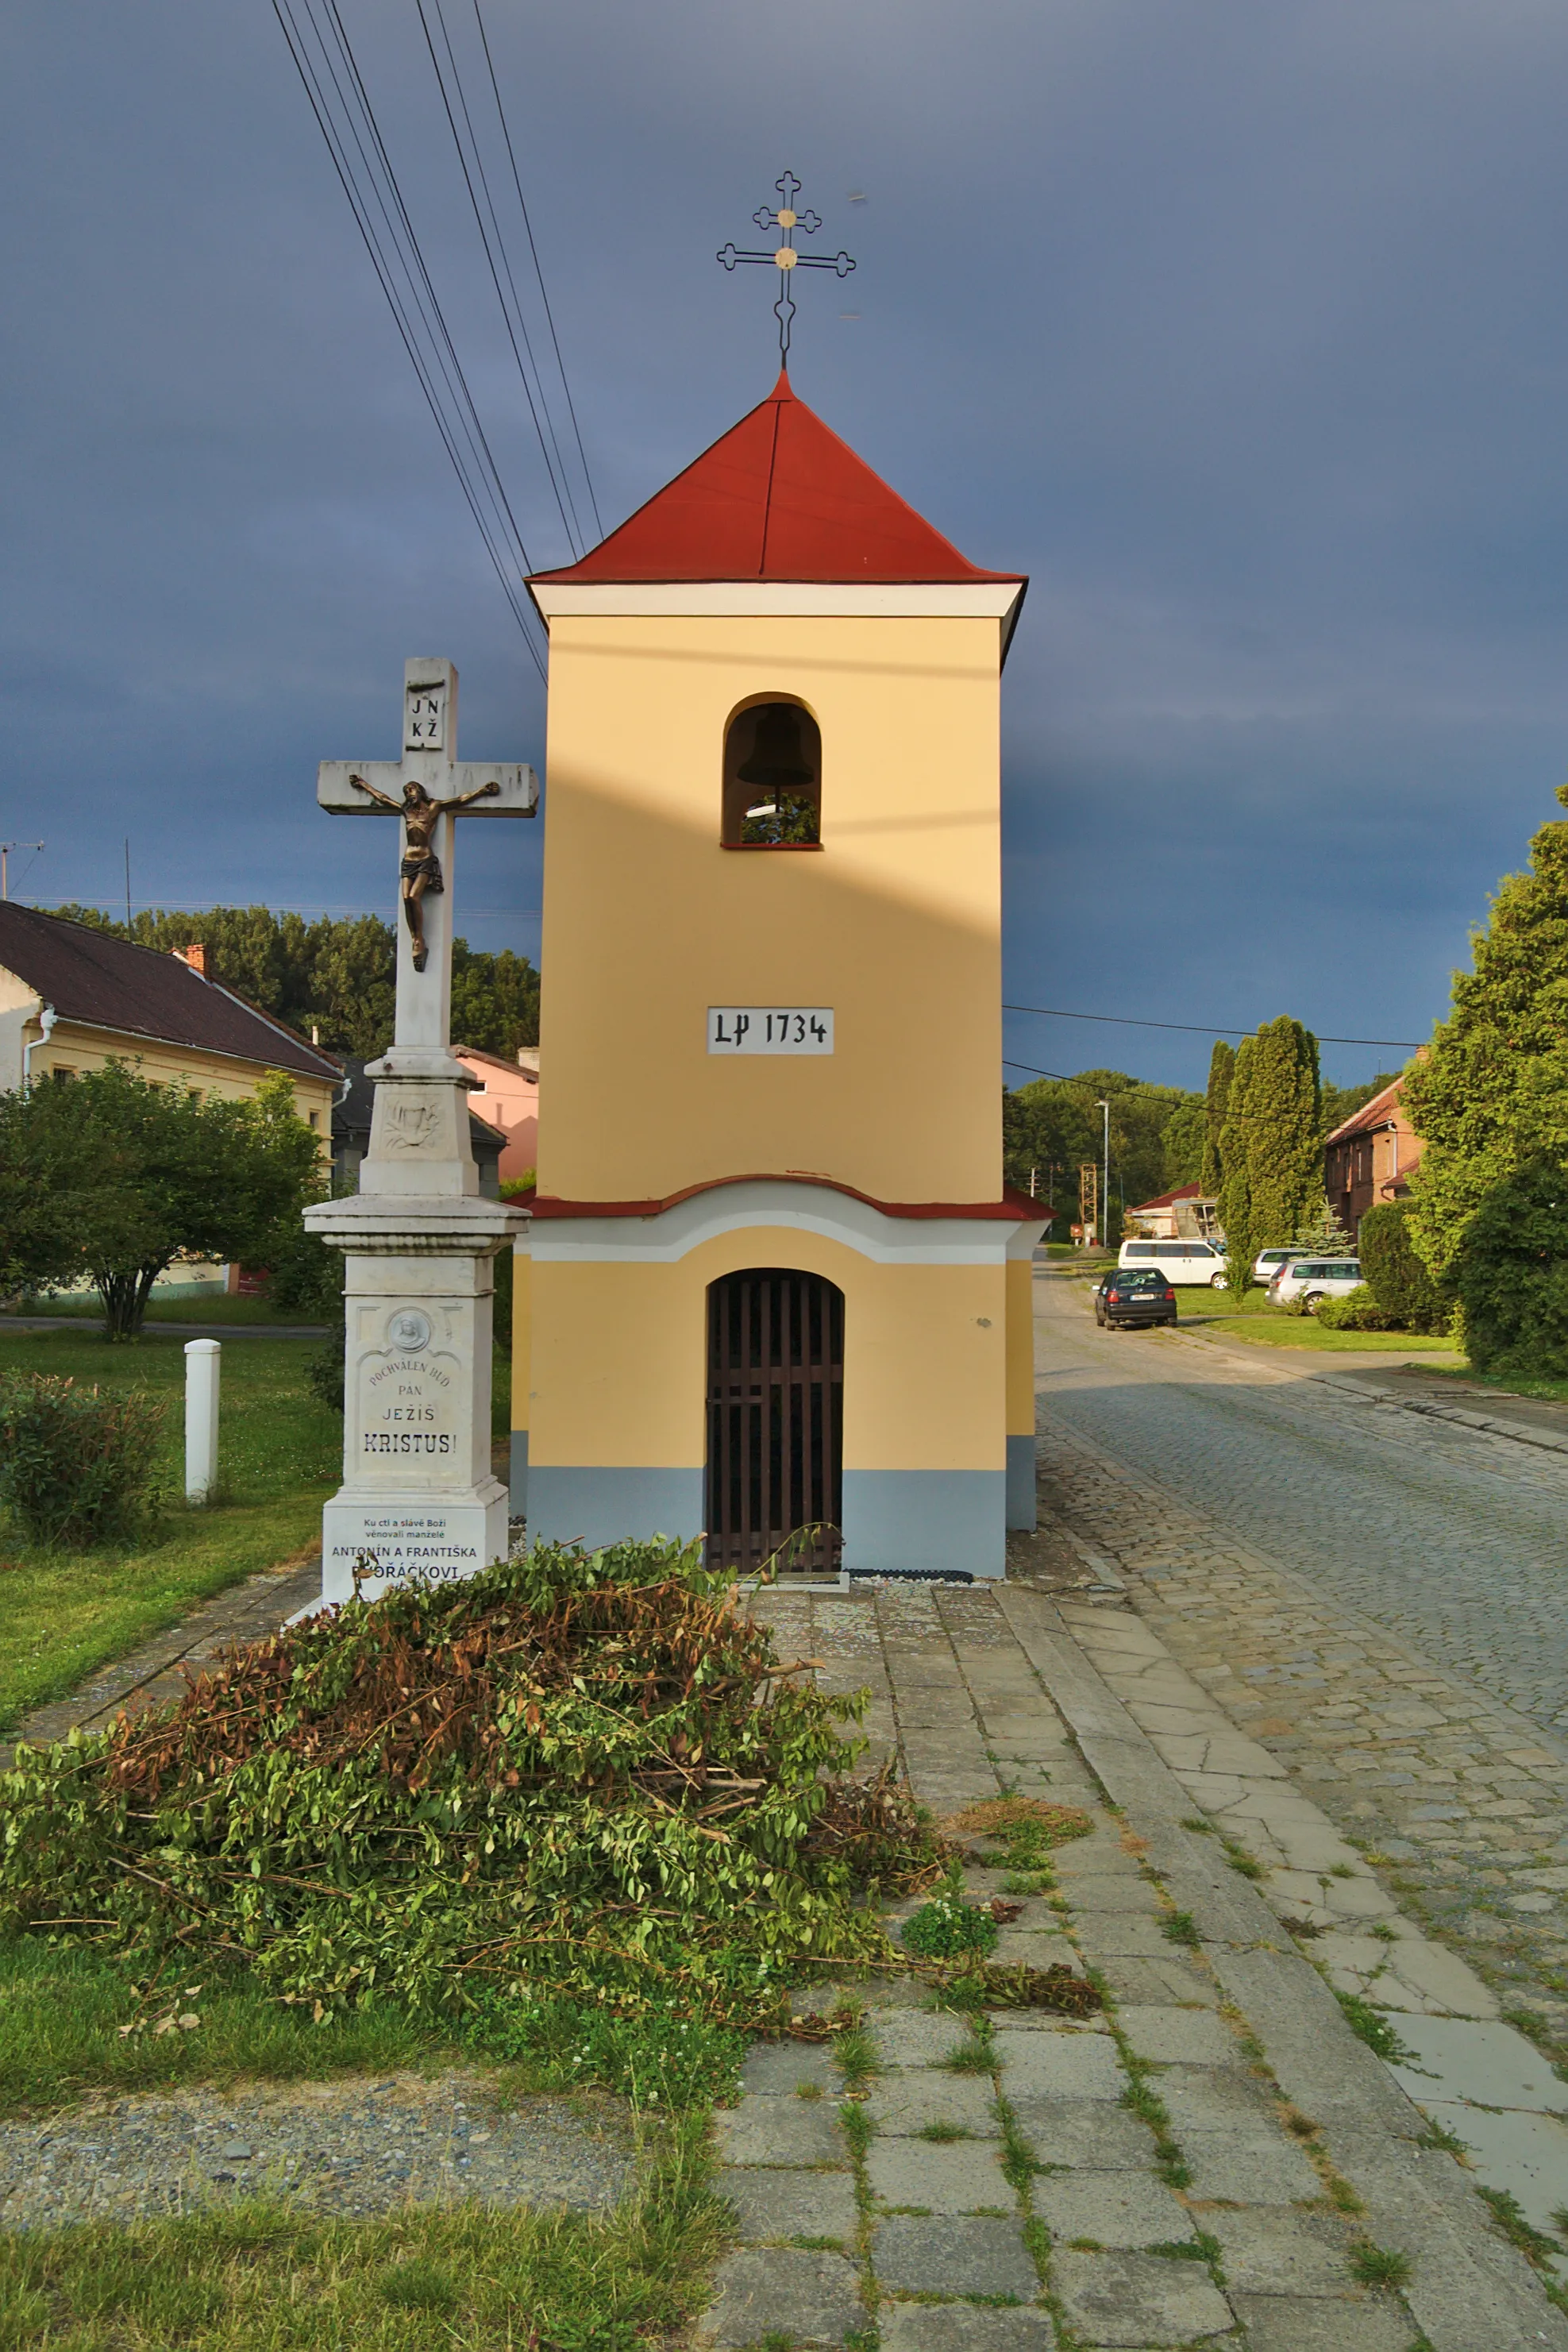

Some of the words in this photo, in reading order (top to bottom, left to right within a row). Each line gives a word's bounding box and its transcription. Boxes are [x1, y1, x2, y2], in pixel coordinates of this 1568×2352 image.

[765, 1014, 827, 1043] 1734
[369, 1358, 428, 1386] POCHVÁLEN
[382, 1404, 434, 1421] JEŽÍŠ
[364, 1433, 457, 1453] KRISTUS!
[395, 1547, 403, 1556] A
[406, 1544, 476, 1557] FRANTIŠKA
[352, 1562, 458, 1579] OŘÁČKOVI
